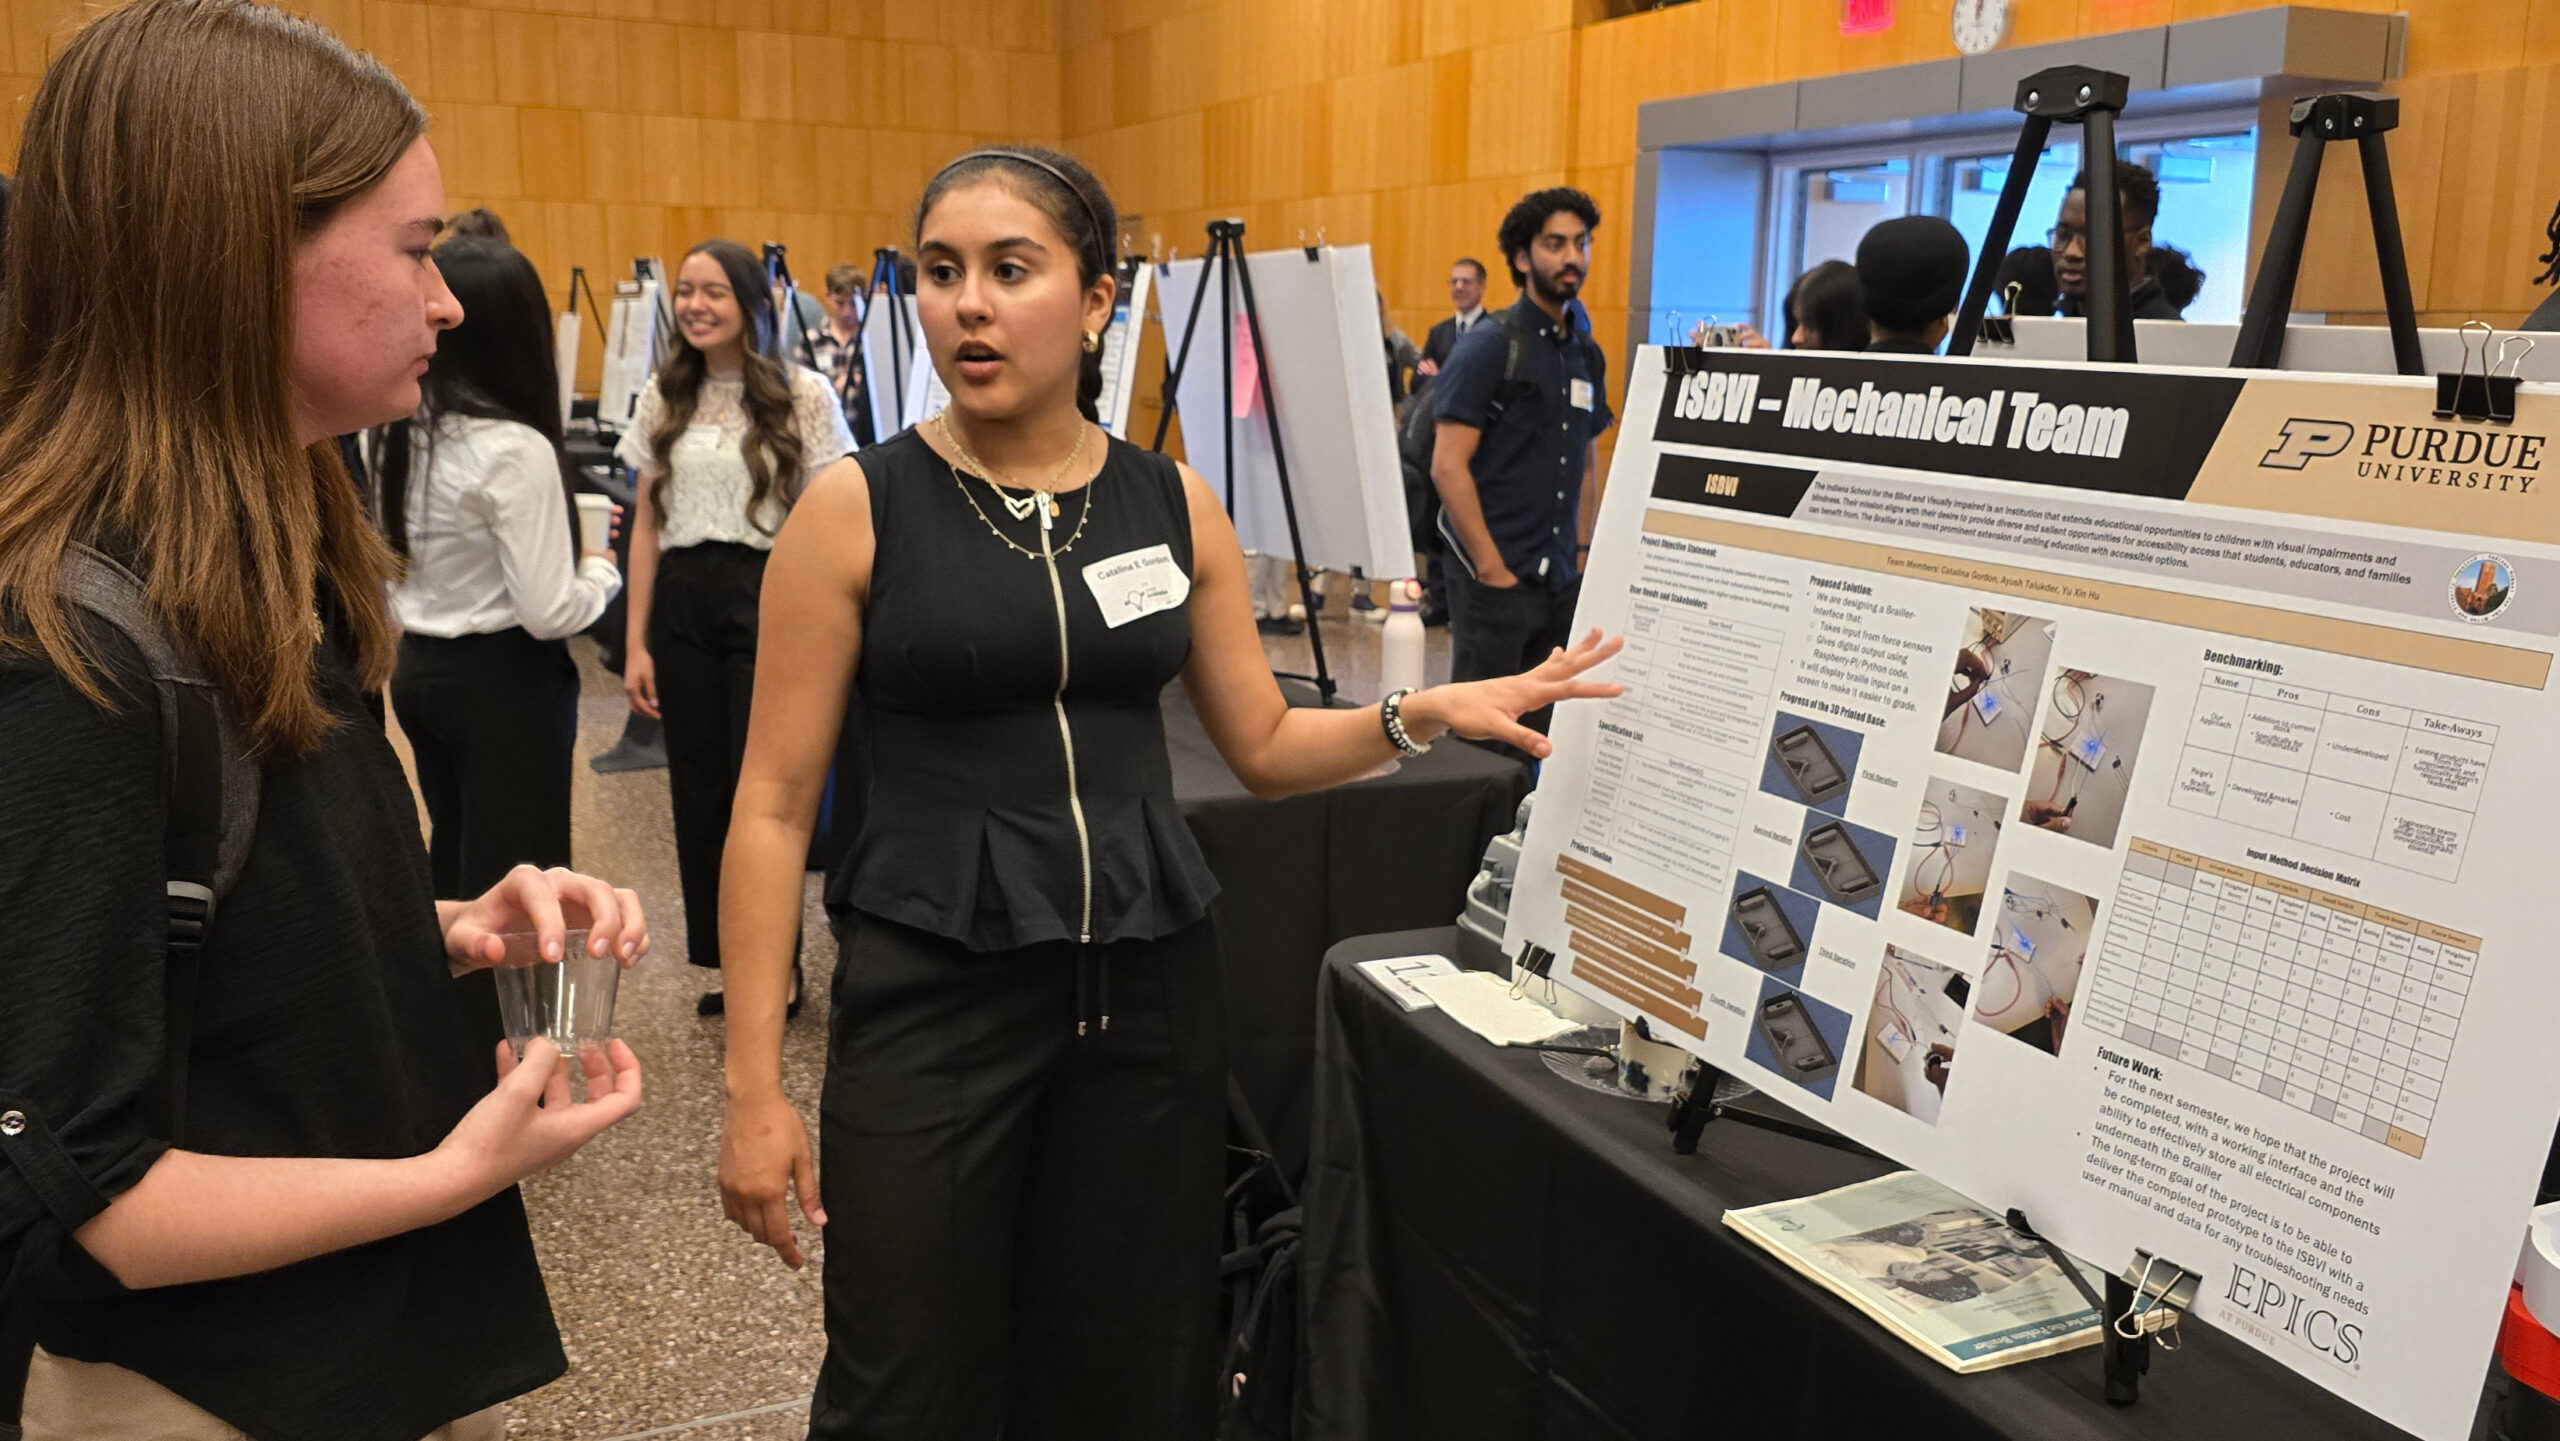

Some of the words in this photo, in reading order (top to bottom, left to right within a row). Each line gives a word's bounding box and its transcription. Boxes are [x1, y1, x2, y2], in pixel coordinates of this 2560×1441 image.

[1674, 371, 1760, 424] ISBVI
[1782, 378, 2005, 446] Mechanical
[2006, 391, 2130, 459] Team
[2361, 423, 2547, 471] PURDUE
[1704, 473, 1739, 497] ISBVI
[2357, 461, 2536, 494] UNIVERSITY
[1808, 506, 1820, 514] can
[1820, 506, 1843, 517] benefit
[1842, 509, 1861, 520] from.
[1861, 511, 1873, 522] The
[1872, 513, 1898, 525] Brailler
[1897, 517, 1904, 526] is
[1904, 518, 1921, 529] their
[1921, 522, 1940, 532] most
[1939, 524, 1977, 537] prominent
[1976, 529, 2013, 542] extension
[2012, 534, 2023, 543] of
[2022, 536, 2051, 550] uniting
[2049, 539, 2090, 554] education
[2090, 546, 2109, 557] with
[2109, 549, 2154, 564] accessible
[2154, 555, 2191, 569] options.
[1814, 481, 1826, 491] The
[1825, 483, 1850, 494] Indiana
[1849, 485, 1872, 497] School
[1871, 488, 1883, 498] for
[1881, 490, 1894, 500] the
[1893, 491, 1913, 502] Blind
[1911, 495, 1926, 504] and
[1926, 495, 1954, 509] Visually
[1953, 499, 1987, 512] Impaired
[1986, 503, 1994, 513] is
[1993, 506, 2005, 514] an
[2004, 505, 2043, 520] institution
[2043, 511, 2061, 522] that
[2061, 514, 2093, 526] extends
[2093, 518, 2144, 533] educational
[2143, 525, 2202, 540] opportunities
[2202, 531, 2213, 542] to
[2214, 533, 2252, 547] children
[2253, 538, 2275, 550] with
[2276, 540, 2306, 554] visual
[2305, 544, 2374, 564] impairments
[2374, 555, 2398, 567] and
[1640, 535, 1661, 548] Project
[1660, 538, 1687, 552] Objective
[1097, 564, 1134, 580] Catalina
[1809, 575, 1843, 591] Proposed
[1841, 580, 1874, 597] Solution:
[1886, 555, 1906, 567] Team
[1906, 559, 1941, 573] Members:
[1940, 565, 1970, 579] Catalina
[1970, 570, 2000, 585] Gordon,
[1999, 575, 2024, 588] Ayush
[2025, 579, 2061, 595] Talukder,
[2062, 585, 2073, 596] Yu
[2073, 587, 2087, 599] Xin
[2087, 590, 2101, 601] Hu
[1629, 584, 1643, 596] User
[1642, 587, 1660, 599] Needs
[1659, 591, 1671, 602] and
[2203, 648, 2285, 677] Benchmarking:
[2213, 675, 2240, 689] Name
[2276, 687, 2300, 701] Pros
[1779, 690, 1810, 708] Progress
[1809, 699, 1819, 710] of
[1817, 700, 1830, 713] the
[1829, 703, 1841, 716] 3D
[1839, 706, 1867, 723] Printed
[1865, 713, 1888, 729] Base:
[2356, 704, 2381, 717] Cons
[2423, 717, 2483, 739] Take-Aways
[1598, 719, 1633, 739] Specification
[2331, 742, 2390, 762] Underdeveloped
[2334, 811, 2352, 823] Cost
[2245, 847, 2268, 862] Input
[2268, 853, 2300, 871] Method
[2299, 862, 2335, 881] Decision
[2335, 872, 2361, 889] Matrix
[2096, 1045, 2130, 1069] Future
[2131, 1058, 2164, 1082] Work:
[2095, 1120, 2159, 1155] underneath
[2161, 1147, 2180, 1163] the
[2181, 1155, 2223, 1182] Brailler
[2103, 1085, 2118, 1101] be
[2119, 1094, 2183, 1128] completed,
[2185, 1120, 2209, 1138] with
[2210, 1132, 2219, 1142] a
[2221, 1136, 2268, 1165] working
[2267, 1154, 2318, 1186] interface
[2319, 1180, 2343, 1197] and
[2344, 1189, 2365, 1207] the
[2107, 1069, 2127, 1085] For
[2128, 1078, 2147, 1094] the
[2148, 1088, 2175, 1105] next
[2175, 1098, 2232, 1130] semester,
[2234, 1122, 2251, 1136] we
[2252, 1127, 2281, 1149] hope
[2283, 1141, 2307, 1161] that
[2308, 1153, 2328, 1170] the
[2328, 1164, 2371, 1190] project
[2373, 1182, 2395, 1200] will
[2098, 1104, 2134, 1127] ability
[2135, 1117, 2147, 1131] to
[2149, 1125, 2208, 1158] effectively
[2207, 1149, 2237, 1169] store
[2238, 1163, 2254, 1177] all
[2255, 1170, 2307, 1201] electrical
[2308, 1195, 2381, 1236] components
[2091, 1134, 2111, 1153] The
[2112, 1144, 2167, 1177] long-term
[2167, 1171, 2194, 1189] goal
[2195, 1183, 2209, 1195] of
[2209, 1187, 2228, 1204] the
[2228, 1198, 2269, 1225] project
[2269, 1215, 2281, 1230] is
[2282, 1222, 2294, 1236] to
[2295, 1227, 2311, 1244] be
[2312, 1239, 2338, 1258] able
[2340, 1250, 2353, 1265] to
[2086, 1153, 2125, 1176] deliver
[2125, 1169, 2145, 1185] the
[2146, 1180, 2206, 1213] completed
[2206, 1207, 2260, 1239] prototype
[2261, 1231, 2274, 1246] to
[2275, 1239, 2294, 1256] the
[2295, 1248, 2327, 1273] ISBVI
[2328, 1267, 2353, 1287] with
[2355, 1281, 2364, 1292] a
[2082, 1170, 2107, 1187] user
[2107, 1182, 2153, 1208] manual
[2153, 1201, 2176, 1219] and
[2176, 1211, 2202, 1232] data
[2204, 1223, 2221, 1240] for
[2221, 1234, 2243, 1253] any
[2244, 1243, 2332, 1299] troubleshooting
[2332, 1290, 2369, 1316] needs
[2218, 1309, 2234, 1323] AT
[2234, 1316, 2277, 1347] PURDUE
[2224, 1262, 2364, 1365] EPICS
